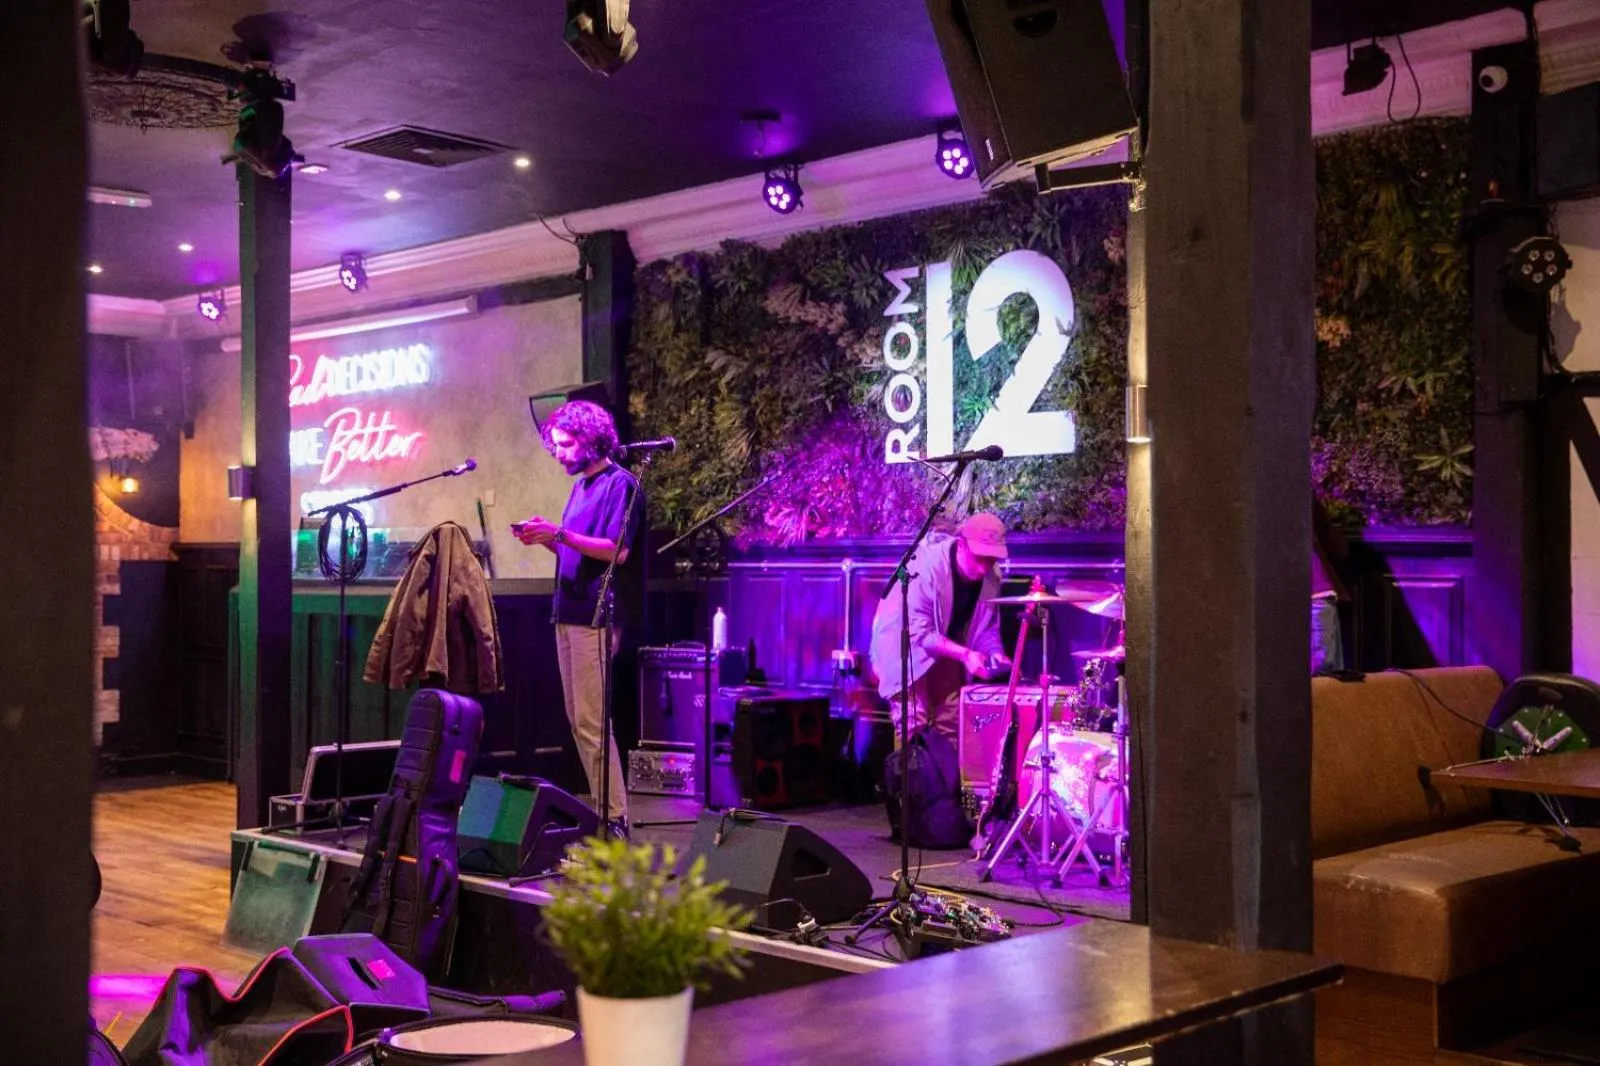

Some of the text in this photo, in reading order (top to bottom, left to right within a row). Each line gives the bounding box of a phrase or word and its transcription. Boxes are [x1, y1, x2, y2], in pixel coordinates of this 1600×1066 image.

[331, 343, 430, 397] DECISIONS
[883, 249, 1076, 464] ROOM 12
[319, 407, 424, 484] Better
